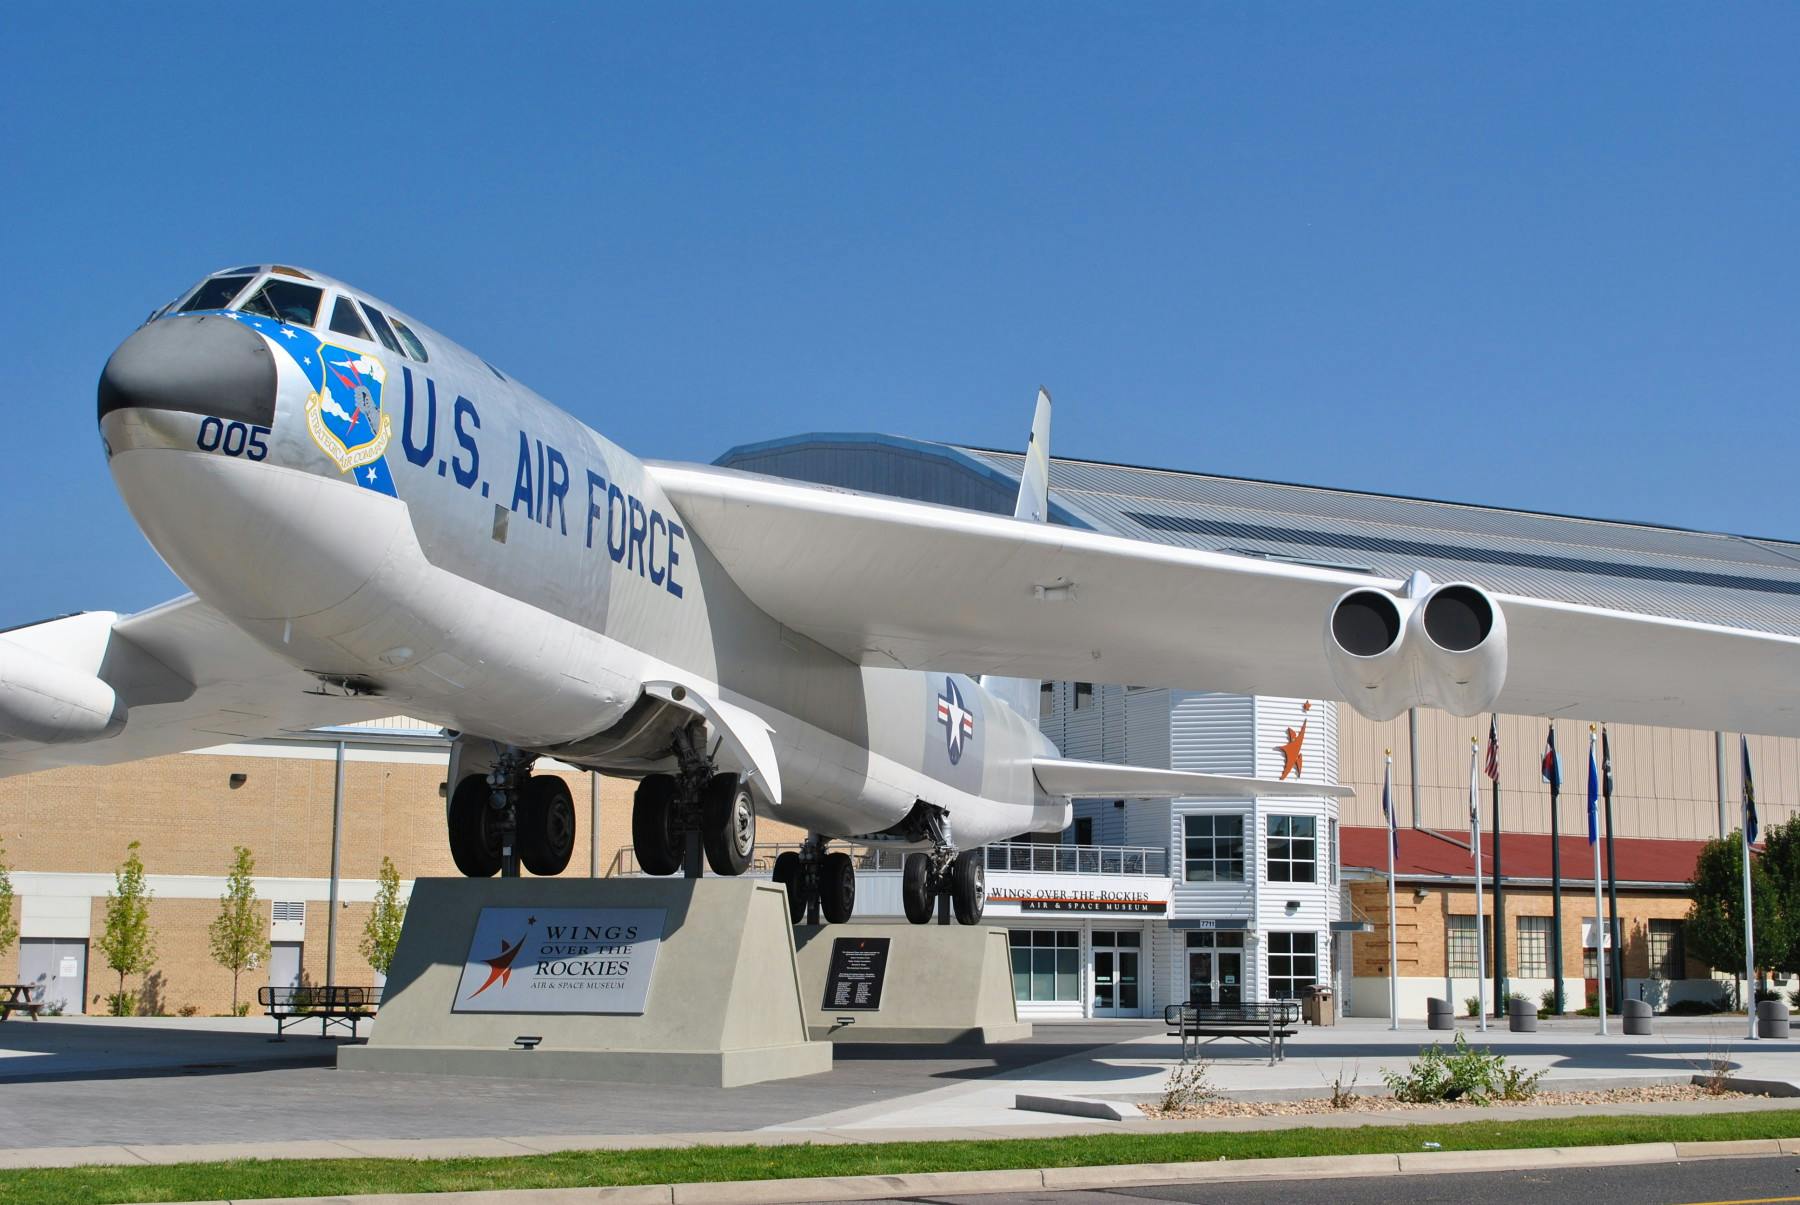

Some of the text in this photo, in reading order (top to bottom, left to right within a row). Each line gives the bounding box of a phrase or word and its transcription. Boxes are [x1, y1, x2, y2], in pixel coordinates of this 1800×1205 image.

[197, 417, 272, 461] 005
[310, 409, 342, 460] STRATEGIC
[401, 366, 684, 599] U.S. AIR FORCE
[991, 887, 1149, 901] WINGS OVER THE ROCKIES
[1068, 902, 1100, 910] SPACE
[1106, 903, 1149, 911] MUSEUM
[547, 926, 638, 939] WINGS
[539, 945, 632, 955] OVER THE
[536, 961, 630, 975] ROCKIES
